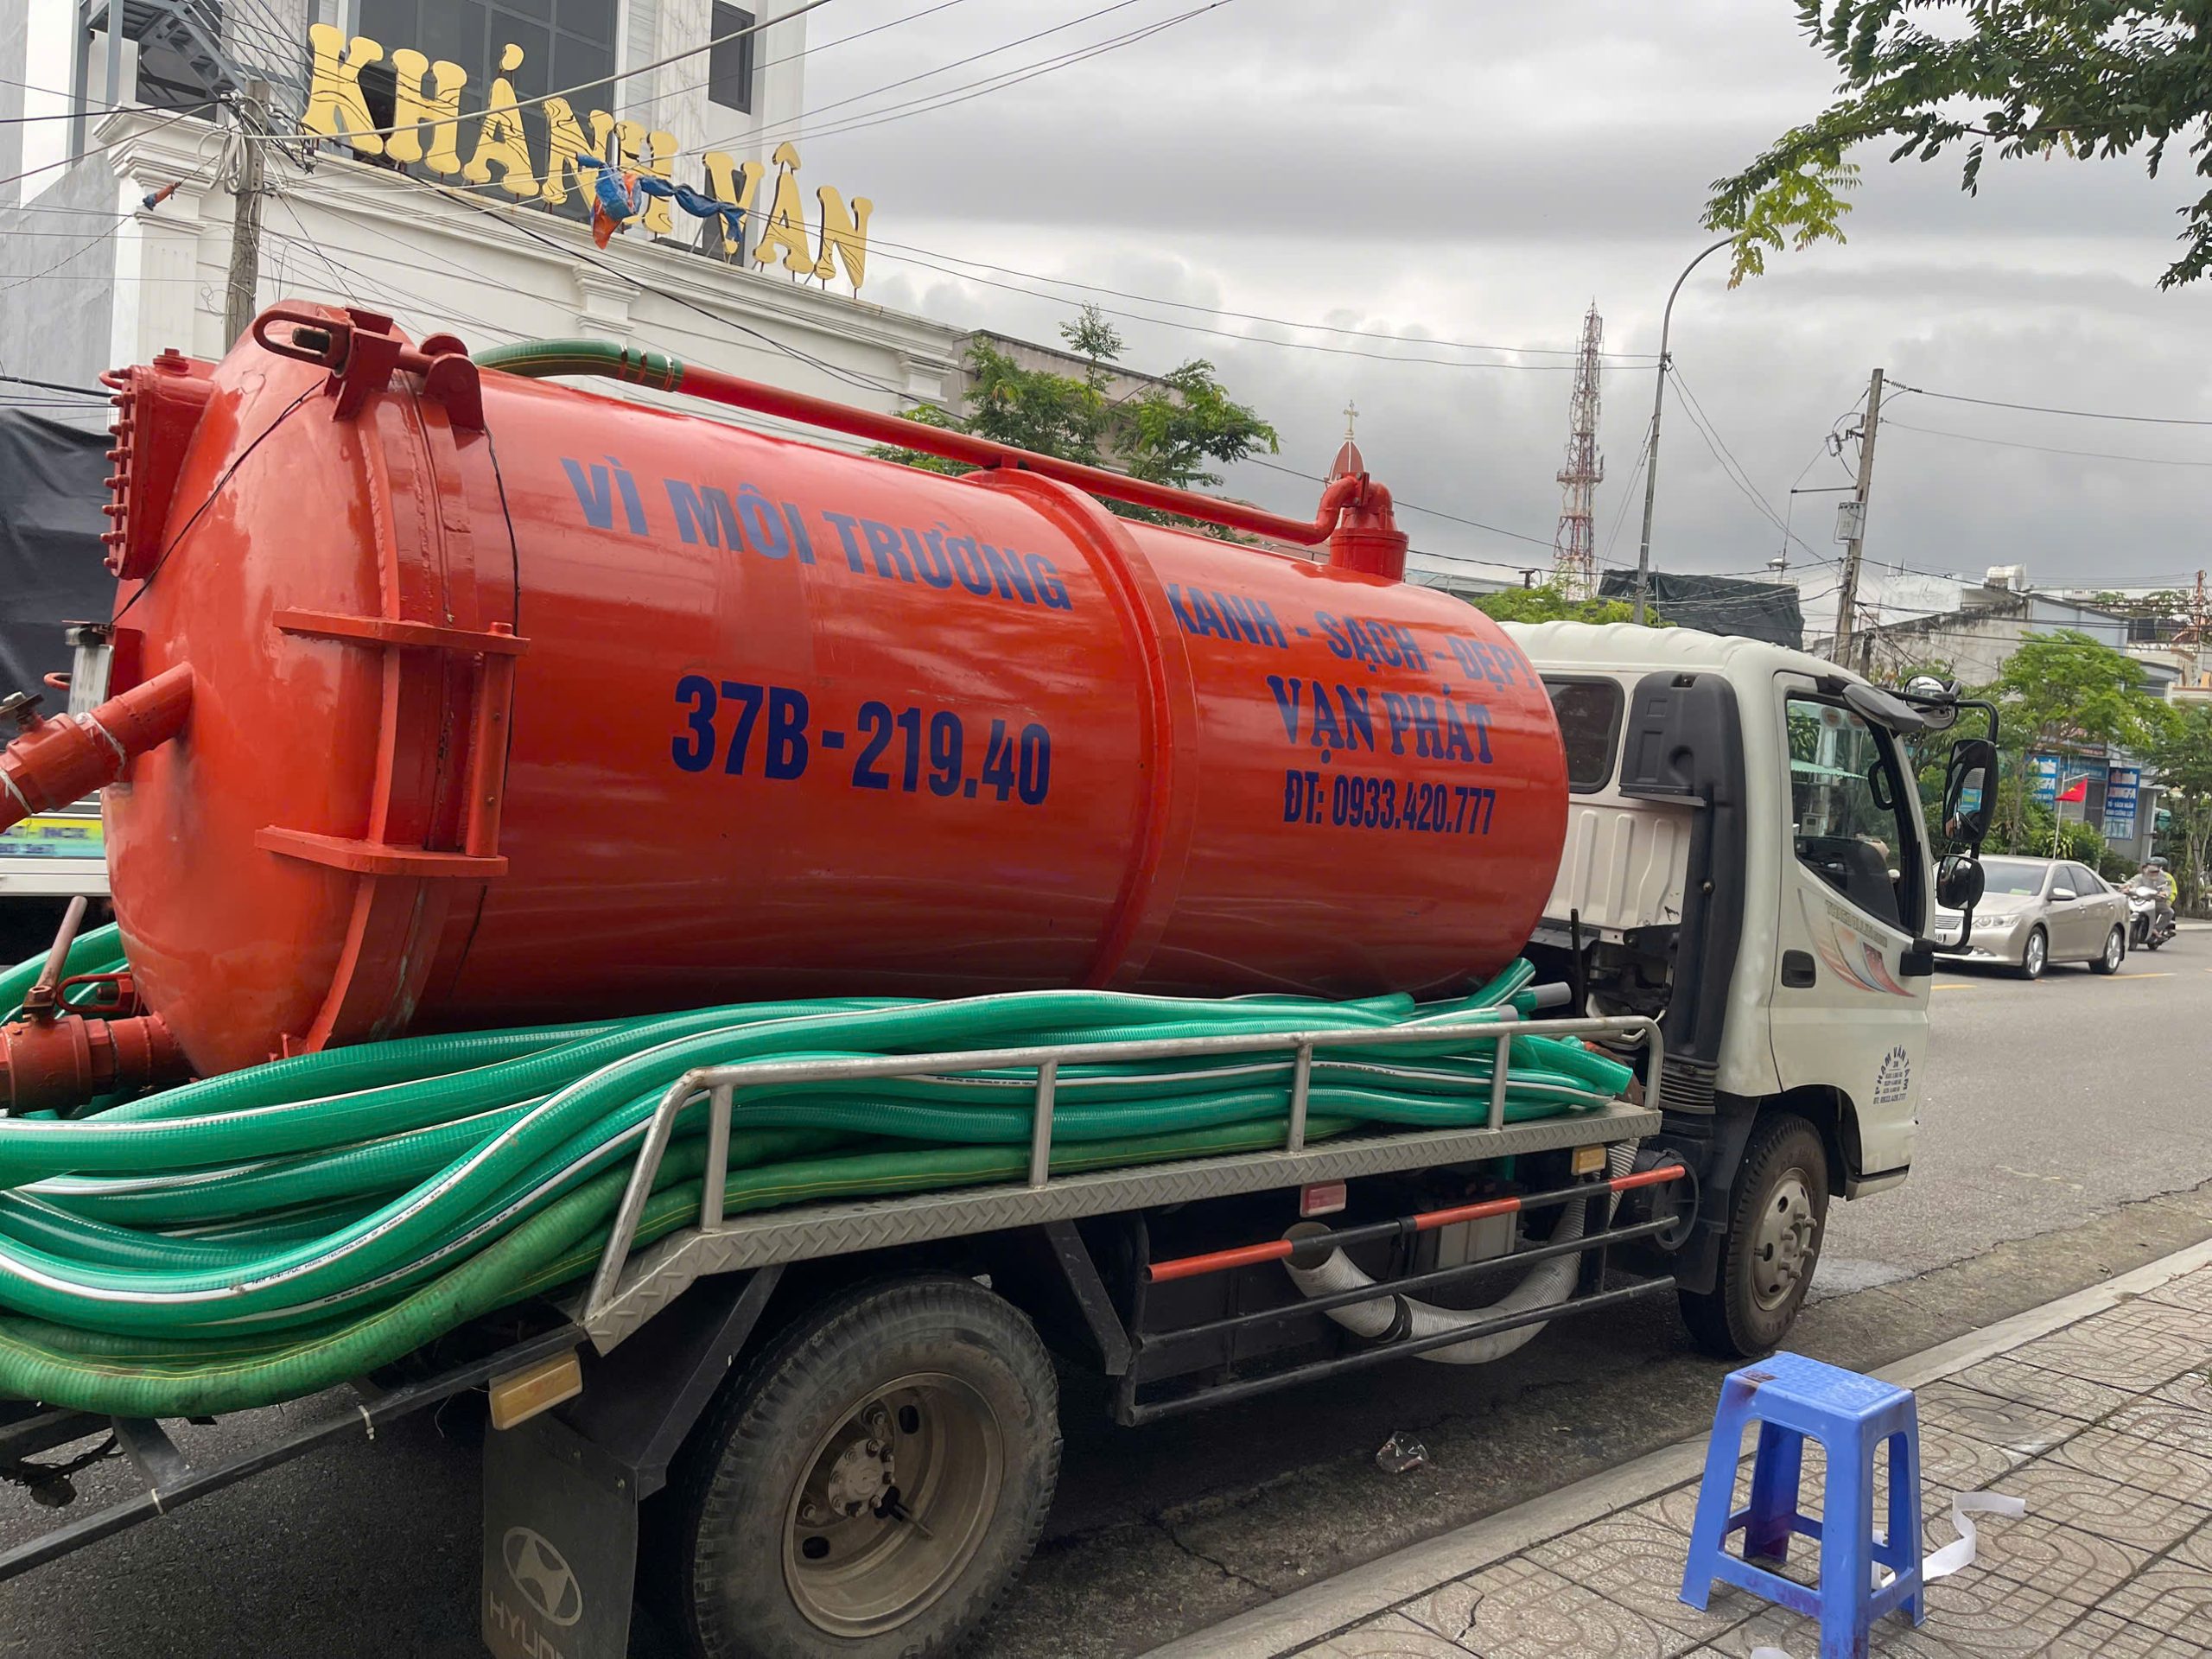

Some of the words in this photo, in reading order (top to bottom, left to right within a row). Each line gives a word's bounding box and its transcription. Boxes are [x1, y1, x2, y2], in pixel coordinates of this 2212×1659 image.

[702, 142, 874, 289] VÂN
[560, 455, 649, 537] VÌ
[664, 479, 816, 565] MÔI
[820, 511, 1073, 611] TRƯỜNG
[1314, 611, 1429, 673] SẠCH
[1267, 675, 1375, 764] VẠN
[1380, 683, 1494, 764] PHÁT
[1332, 777, 1496, 836] 0933.420.777
